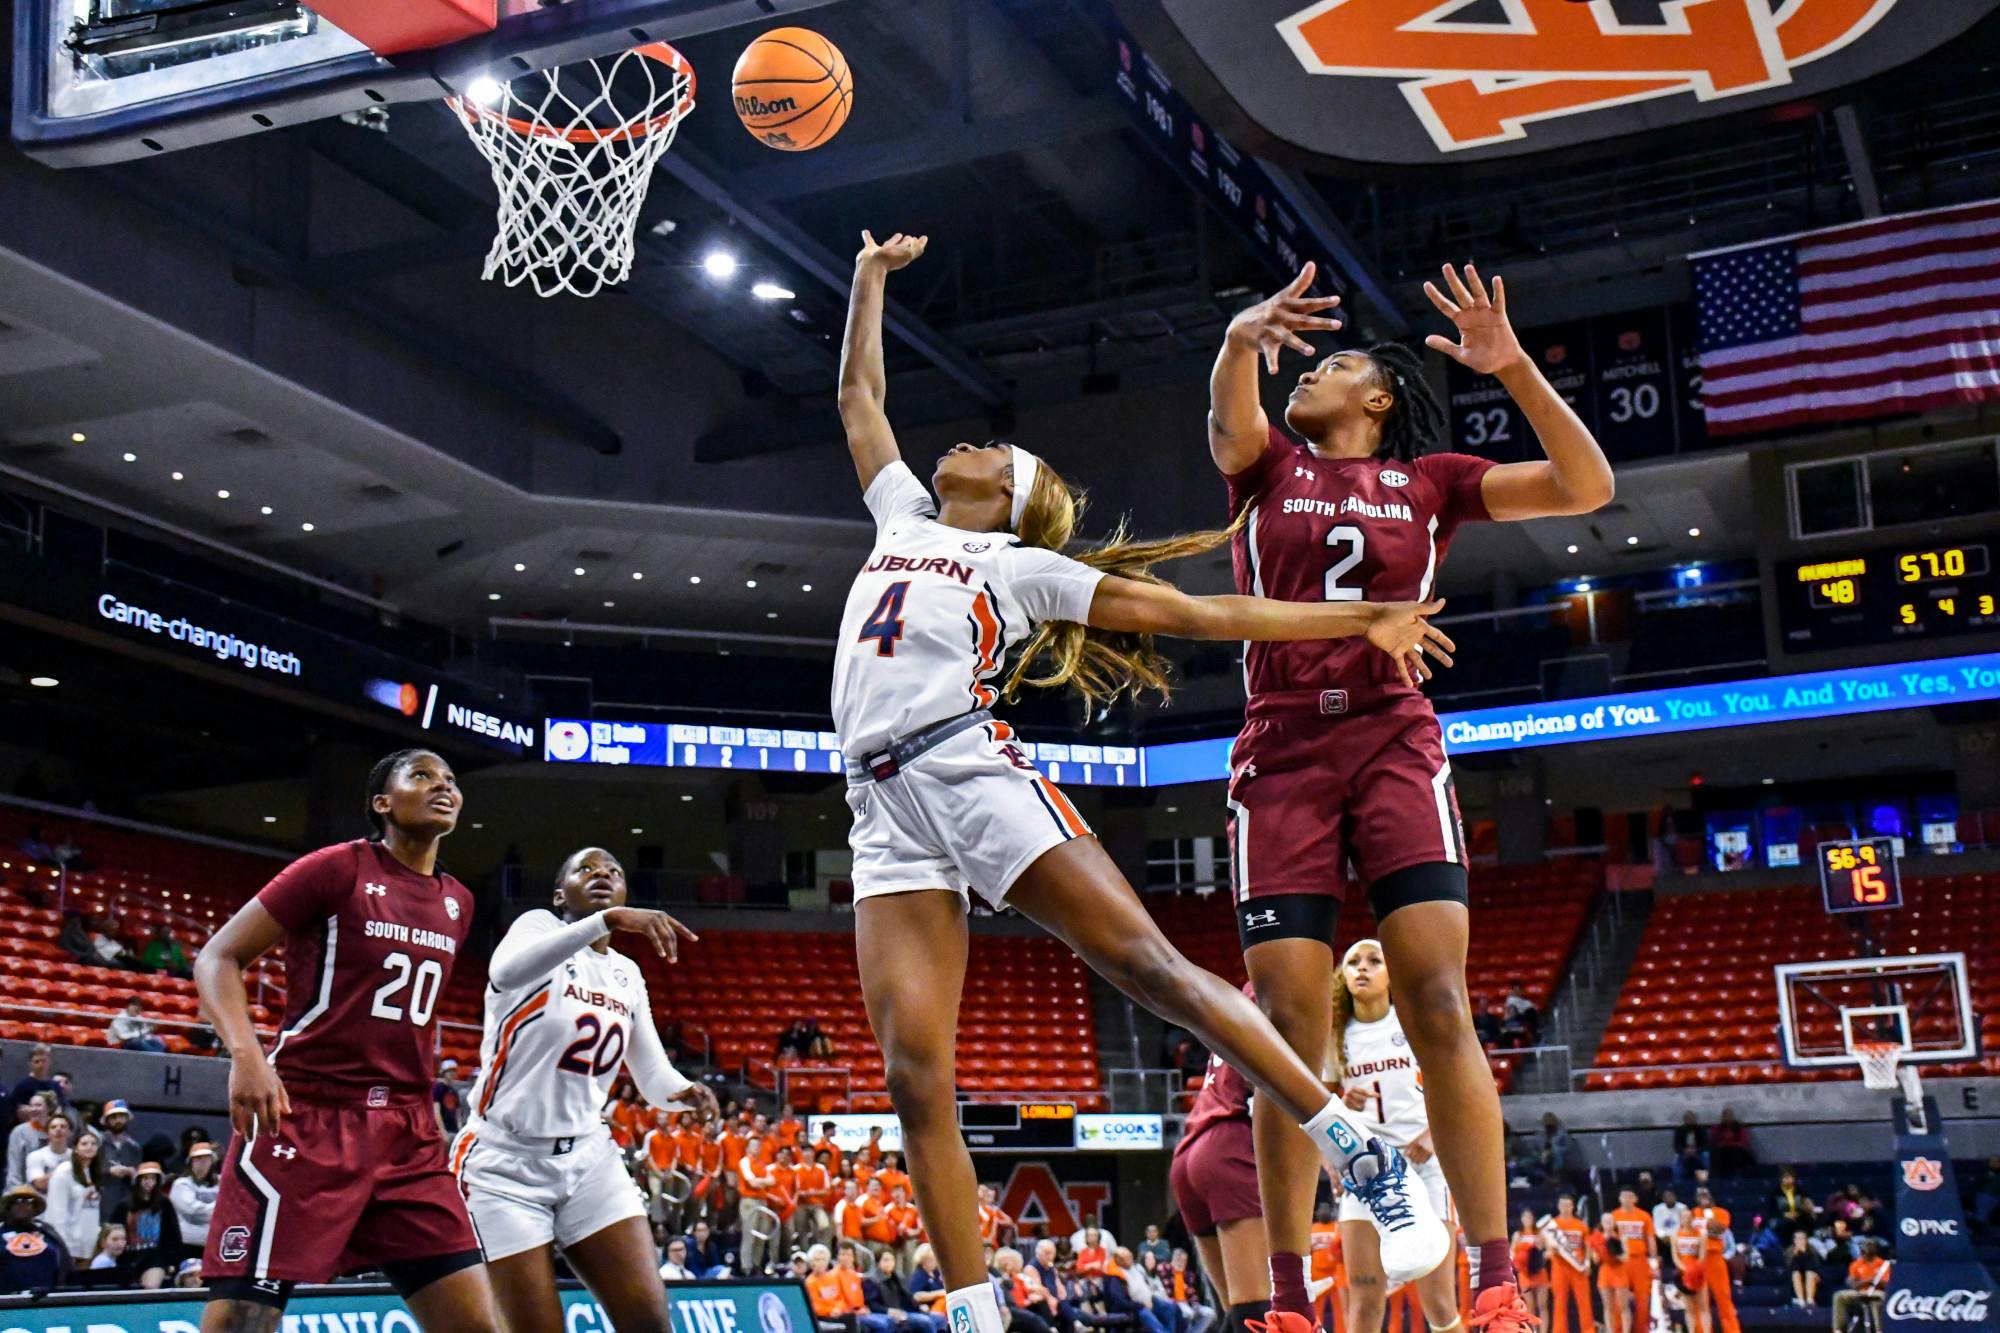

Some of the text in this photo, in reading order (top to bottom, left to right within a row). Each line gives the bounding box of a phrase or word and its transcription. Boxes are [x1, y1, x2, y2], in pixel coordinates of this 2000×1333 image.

[1601, 362, 1662, 382] MITCHELL
[1452, 386, 1510, 407] FREDERIC
[1609, 384, 1660, 423] 30
[1464, 408, 1512, 446] 32
[1380, 472, 1408, 486] SEC
[1283, 497, 1413, 522] SOUTH CAROLINA
[1324, 526, 1365, 601] 2
[1900, 549, 1965, 582] 57.0
[1821, 579, 1855, 604] 48
[857, 581, 912, 657] 4
[1900, 595, 1994, 624] 5 4 3
[98, 594, 300, 676] Game-changing tech
[447, 703, 534, 747] NISSAN
[1446, 713, 1577, 744] Champions
[1581, 706, 1605, 730] of
[1610, 704, 1661, 727] You.
[1666, 698, 1718, 719] You.
[1723, 692, 1776, 714] You.
[1783, 684, 1834, 708] And
[1840, 678, 1896, 702] You.
[1903, 671, 1957, 697] Yes,
[1852, 866, 1887, 902] 15
[365, 921, 456, 955] SOUTH CAROLIN
[371, 952, 442, 1027] 20
[556, 1012, 624, 1077] 20
[164, 1065, 181, 1095] H
[1372, 1081, 1386, 1125] 1
[1962, 1086, 1979, 1110] E
[1919, 1219, 1960, 1236] PNC
